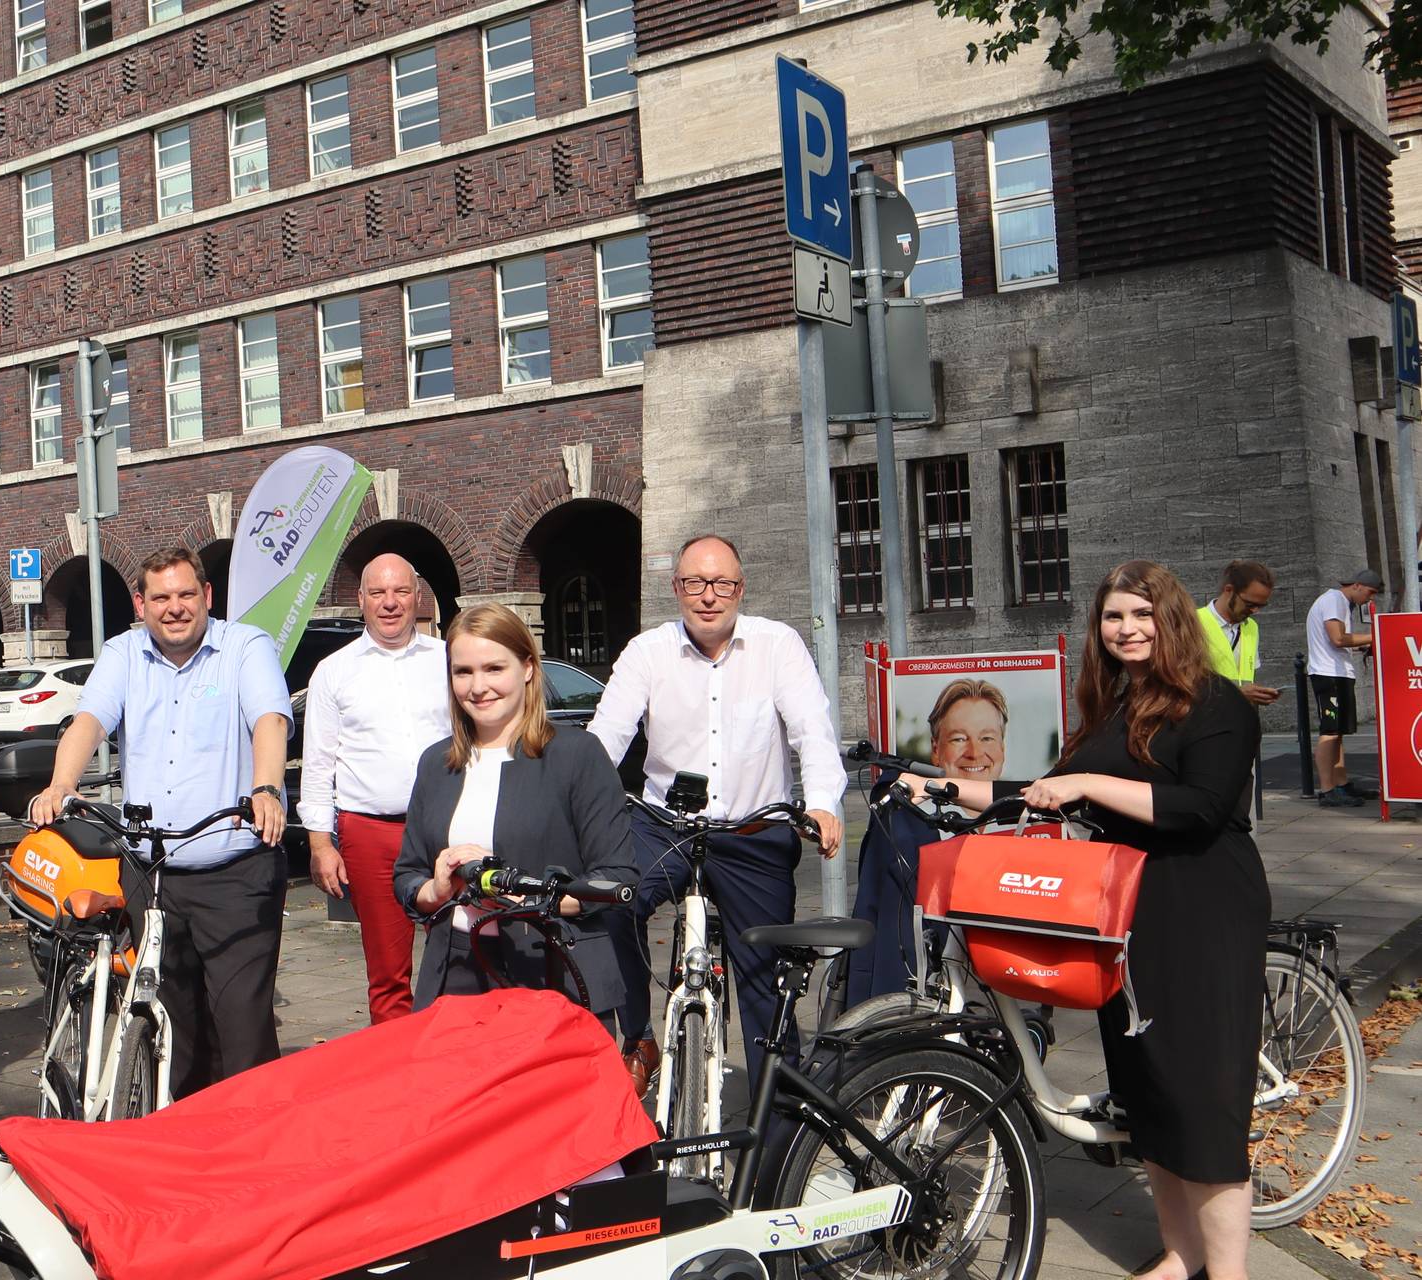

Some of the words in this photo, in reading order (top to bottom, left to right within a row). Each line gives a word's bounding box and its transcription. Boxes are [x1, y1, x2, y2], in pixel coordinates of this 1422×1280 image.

[795, 88, 834, 221] P
[1401, 306, 1414, 371] P
[293, 463, 326, 512] OBERHAUSEN
[272, 468, 339, 567] RADROUTEN
[17, 552, 34, 576] P
[275, 605, 300, 656] EWEGT
[294, 572, 318, 608] MICH.
[908, 661, 975, 672] OBERBÜRGERMEISTER
[977, 659, 991, 669] FÜR
[993, 658, 1042, 668] OBERHAUSEN
[22, 867, 55, 893] SHARING
[1012, 887, 1040, 896] UNSERER
[1022, 968, 1060, 977] VAUDE
[812, 1212, 889, 1241] RADROUTEN
[813, 1199, 888, 1227] OBERHAUSEN
